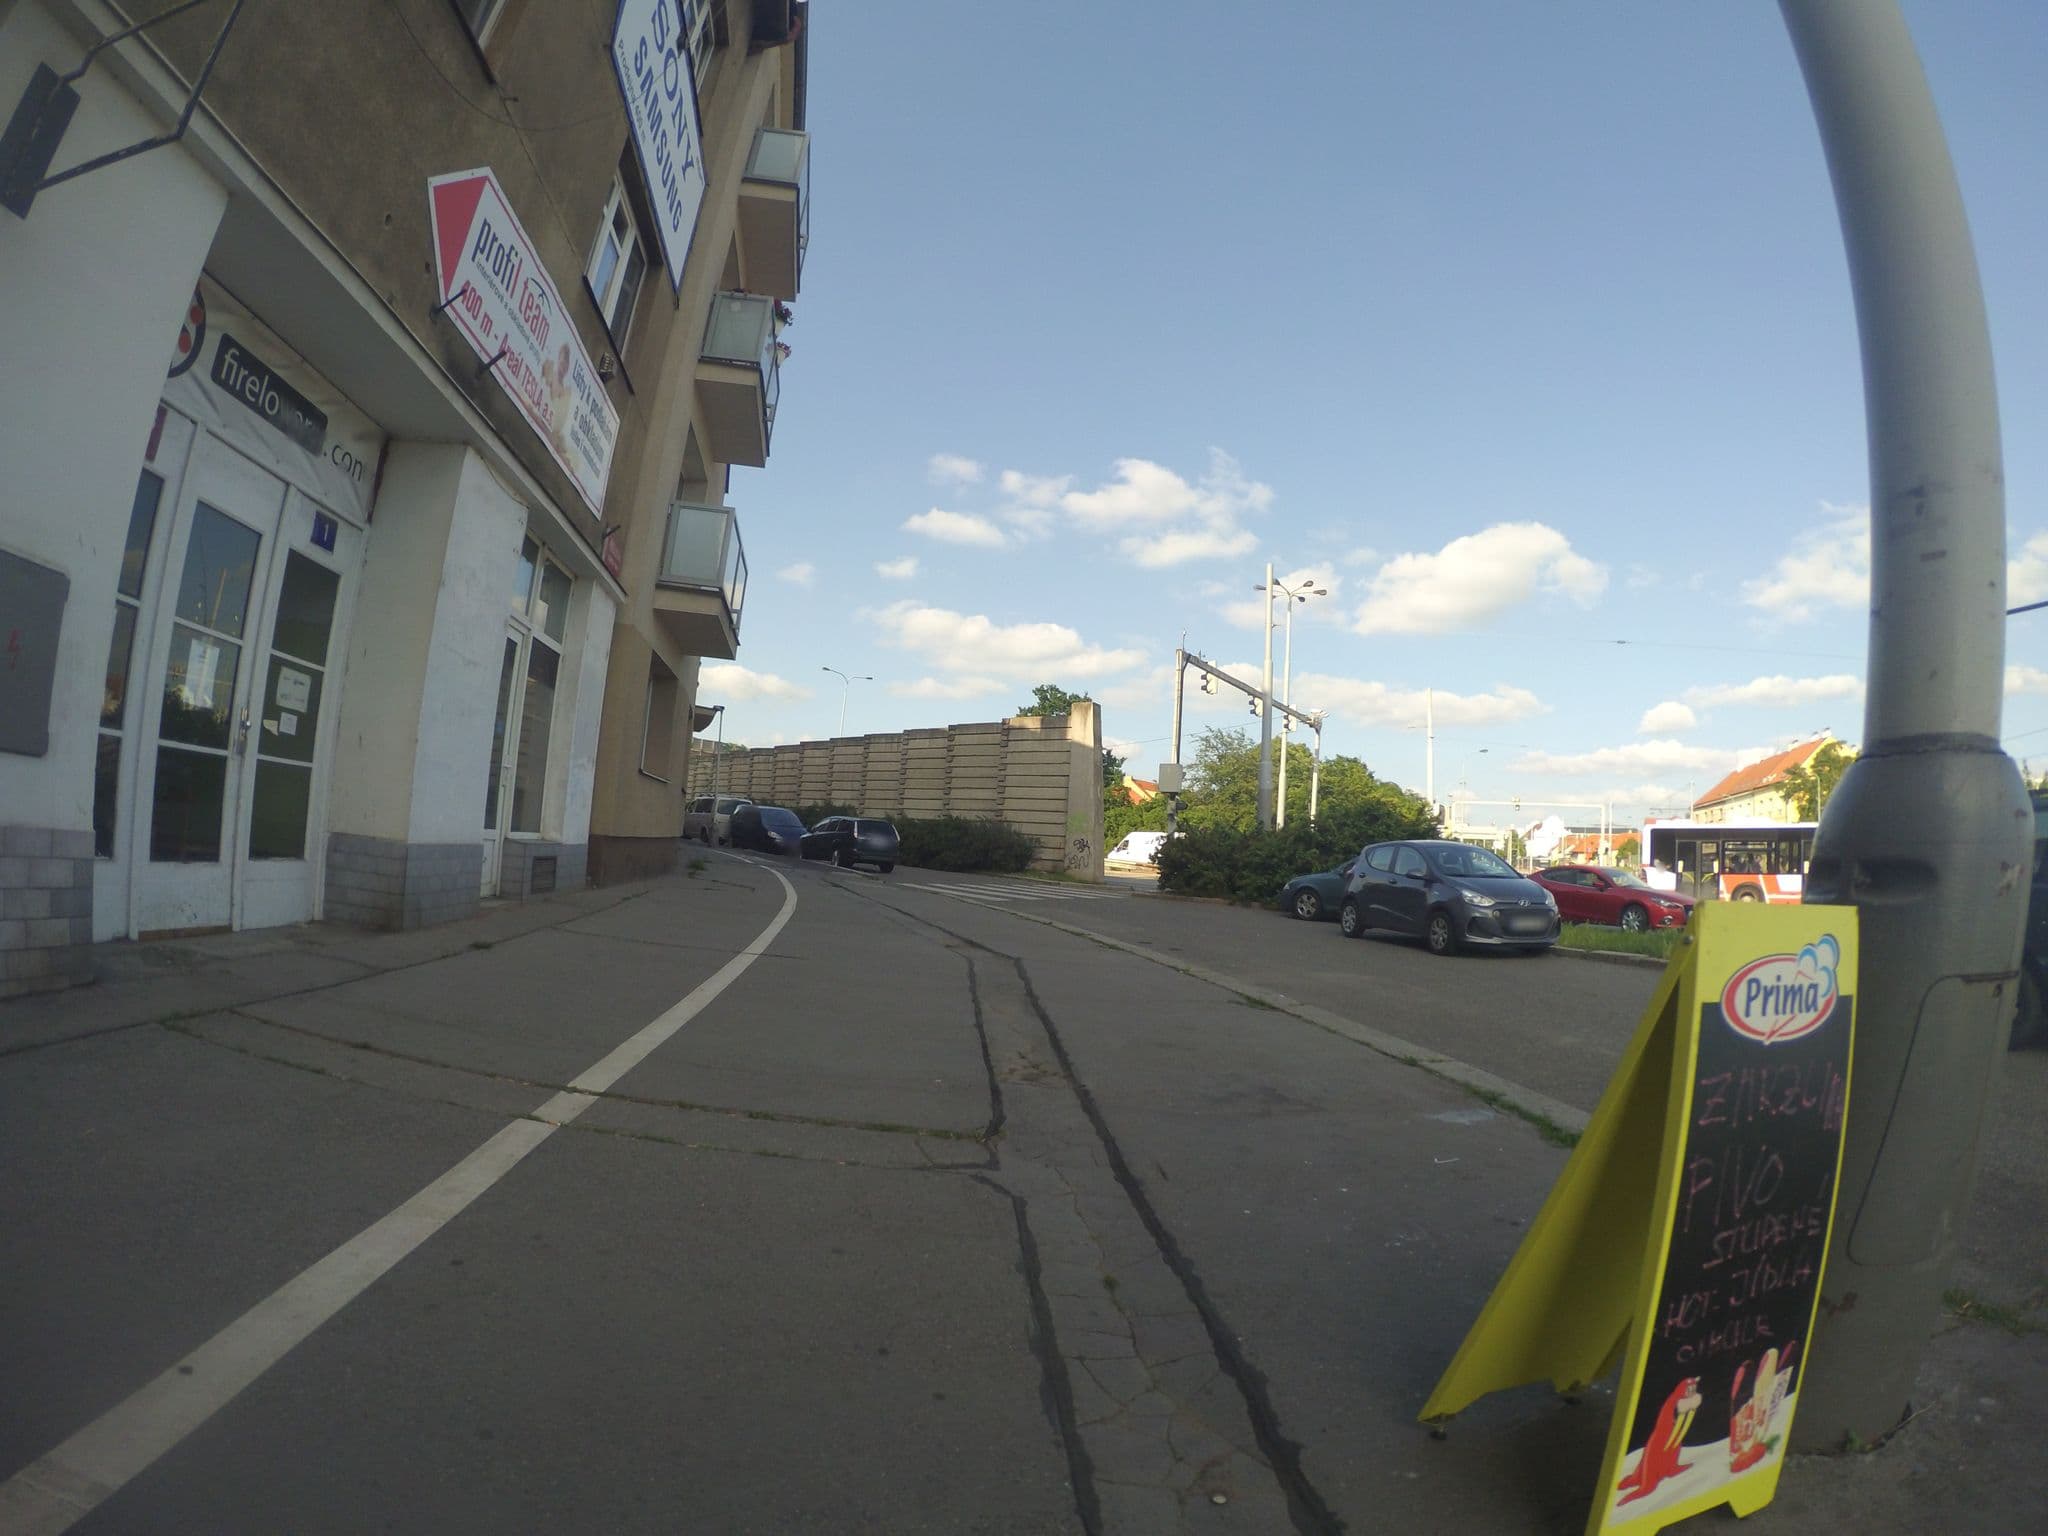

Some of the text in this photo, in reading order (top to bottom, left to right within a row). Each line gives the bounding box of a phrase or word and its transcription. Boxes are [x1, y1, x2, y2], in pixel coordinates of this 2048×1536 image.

[634, 35, 682, 233] SAMSUNG
[651, 0, 694, 182] SONY
[471, 217, 550, 352] profil team
[480, 311, 493, 338] m
[522, 364, 543, 411] TESLA
[1744, 974, 1819, 1019] Prima
